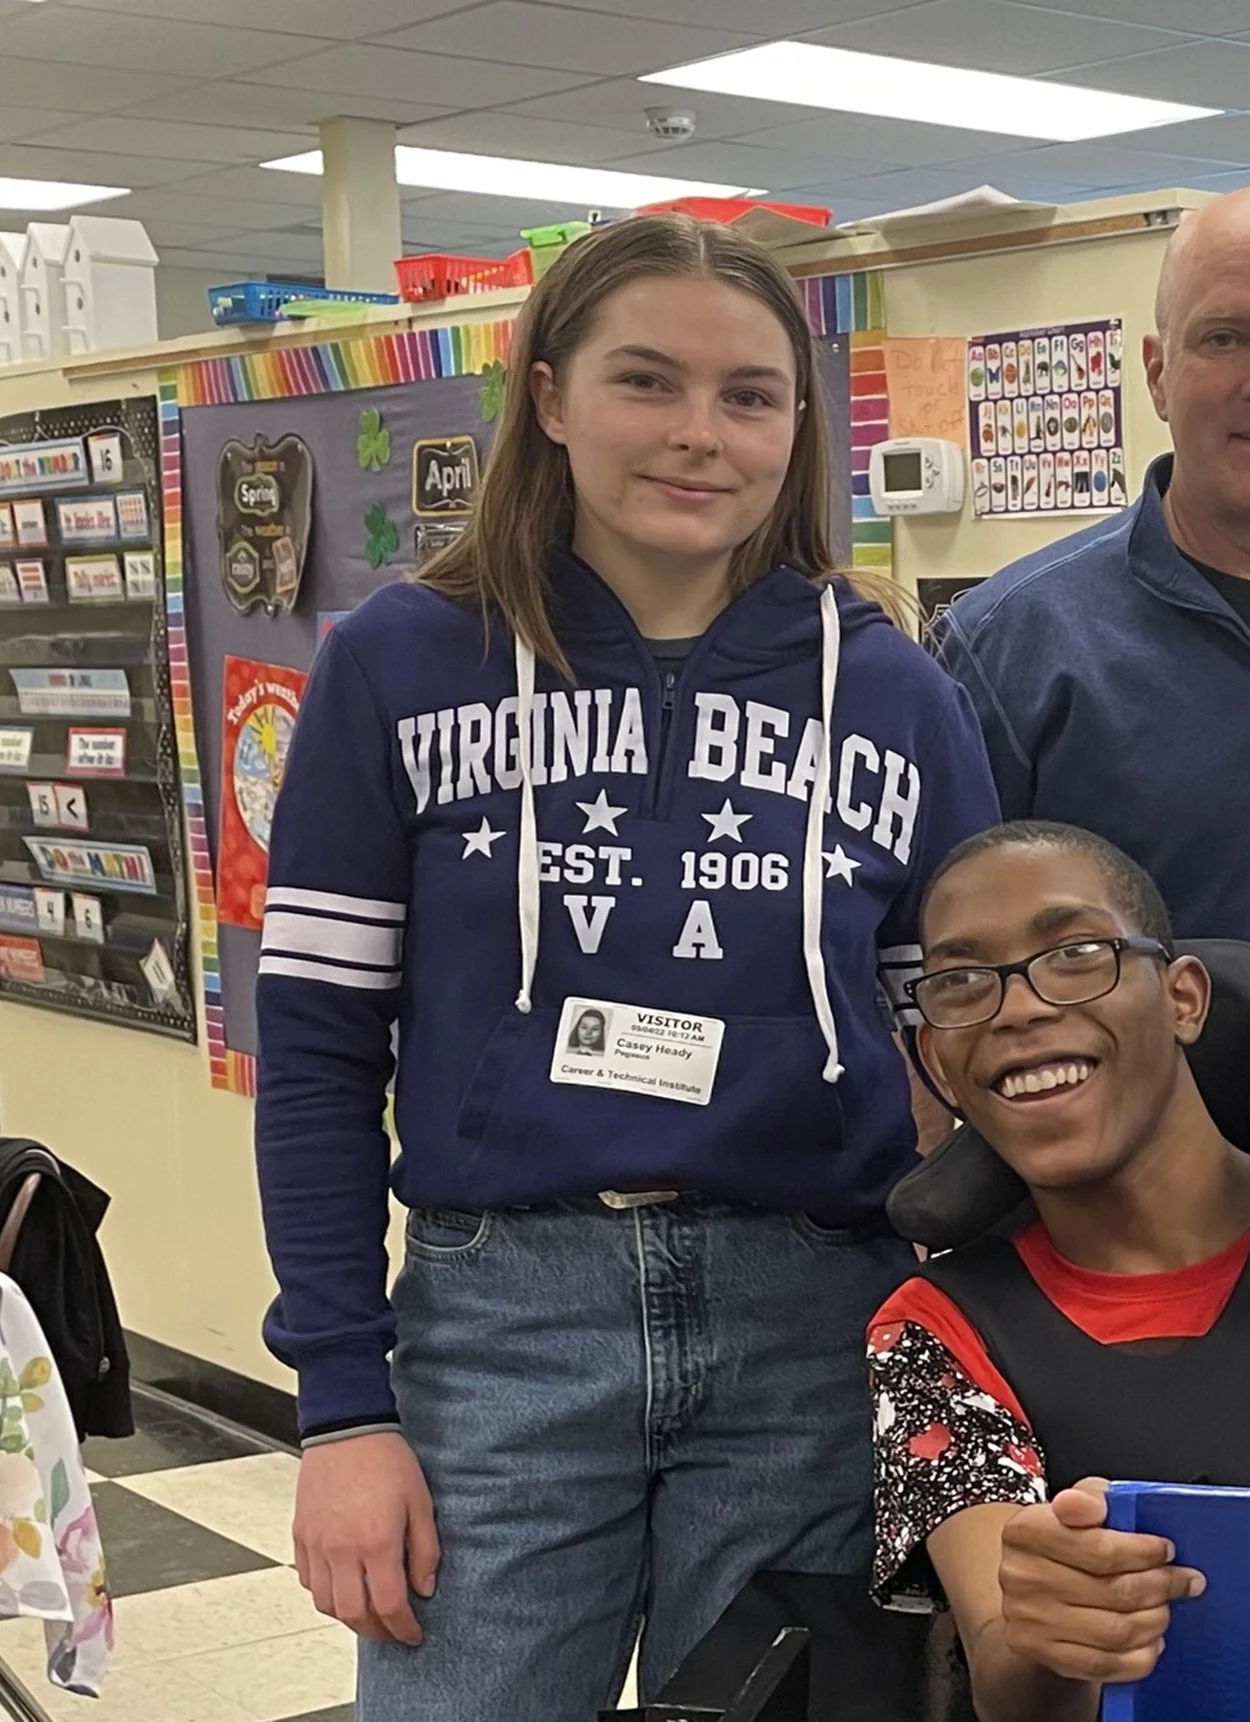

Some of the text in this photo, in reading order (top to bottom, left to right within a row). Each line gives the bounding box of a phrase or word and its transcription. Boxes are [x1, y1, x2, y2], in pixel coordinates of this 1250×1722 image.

[1054, 339, 1064, 352] Ff
[1071, 338, 1084, 353] Gg
[1063, 397, 1076, 409] Oo
[1083, 395, 1094, 409] Pp
[100, 449, 113, 471] 16
[993, 460, 1002, 473] Ss
[425, 457, 471, 497] April
[241, 483, 276, 506] Spring
[227, 679, 264, 726] Today's
[398, 687, 921, 865] VIRGINIA BEACH
[537, 840, 789, 891] EST. 1906
[84, 908, 92, 929] 6
[563, 895, 723, 960] V A
[637, 1012, 704, 1033] VISITOR
[616, 1037, 693, 1060] Casey Heady
[691, 1033, 705, 1042] AM
[561, 1064, 702, 1095] Career & Technical Institute
